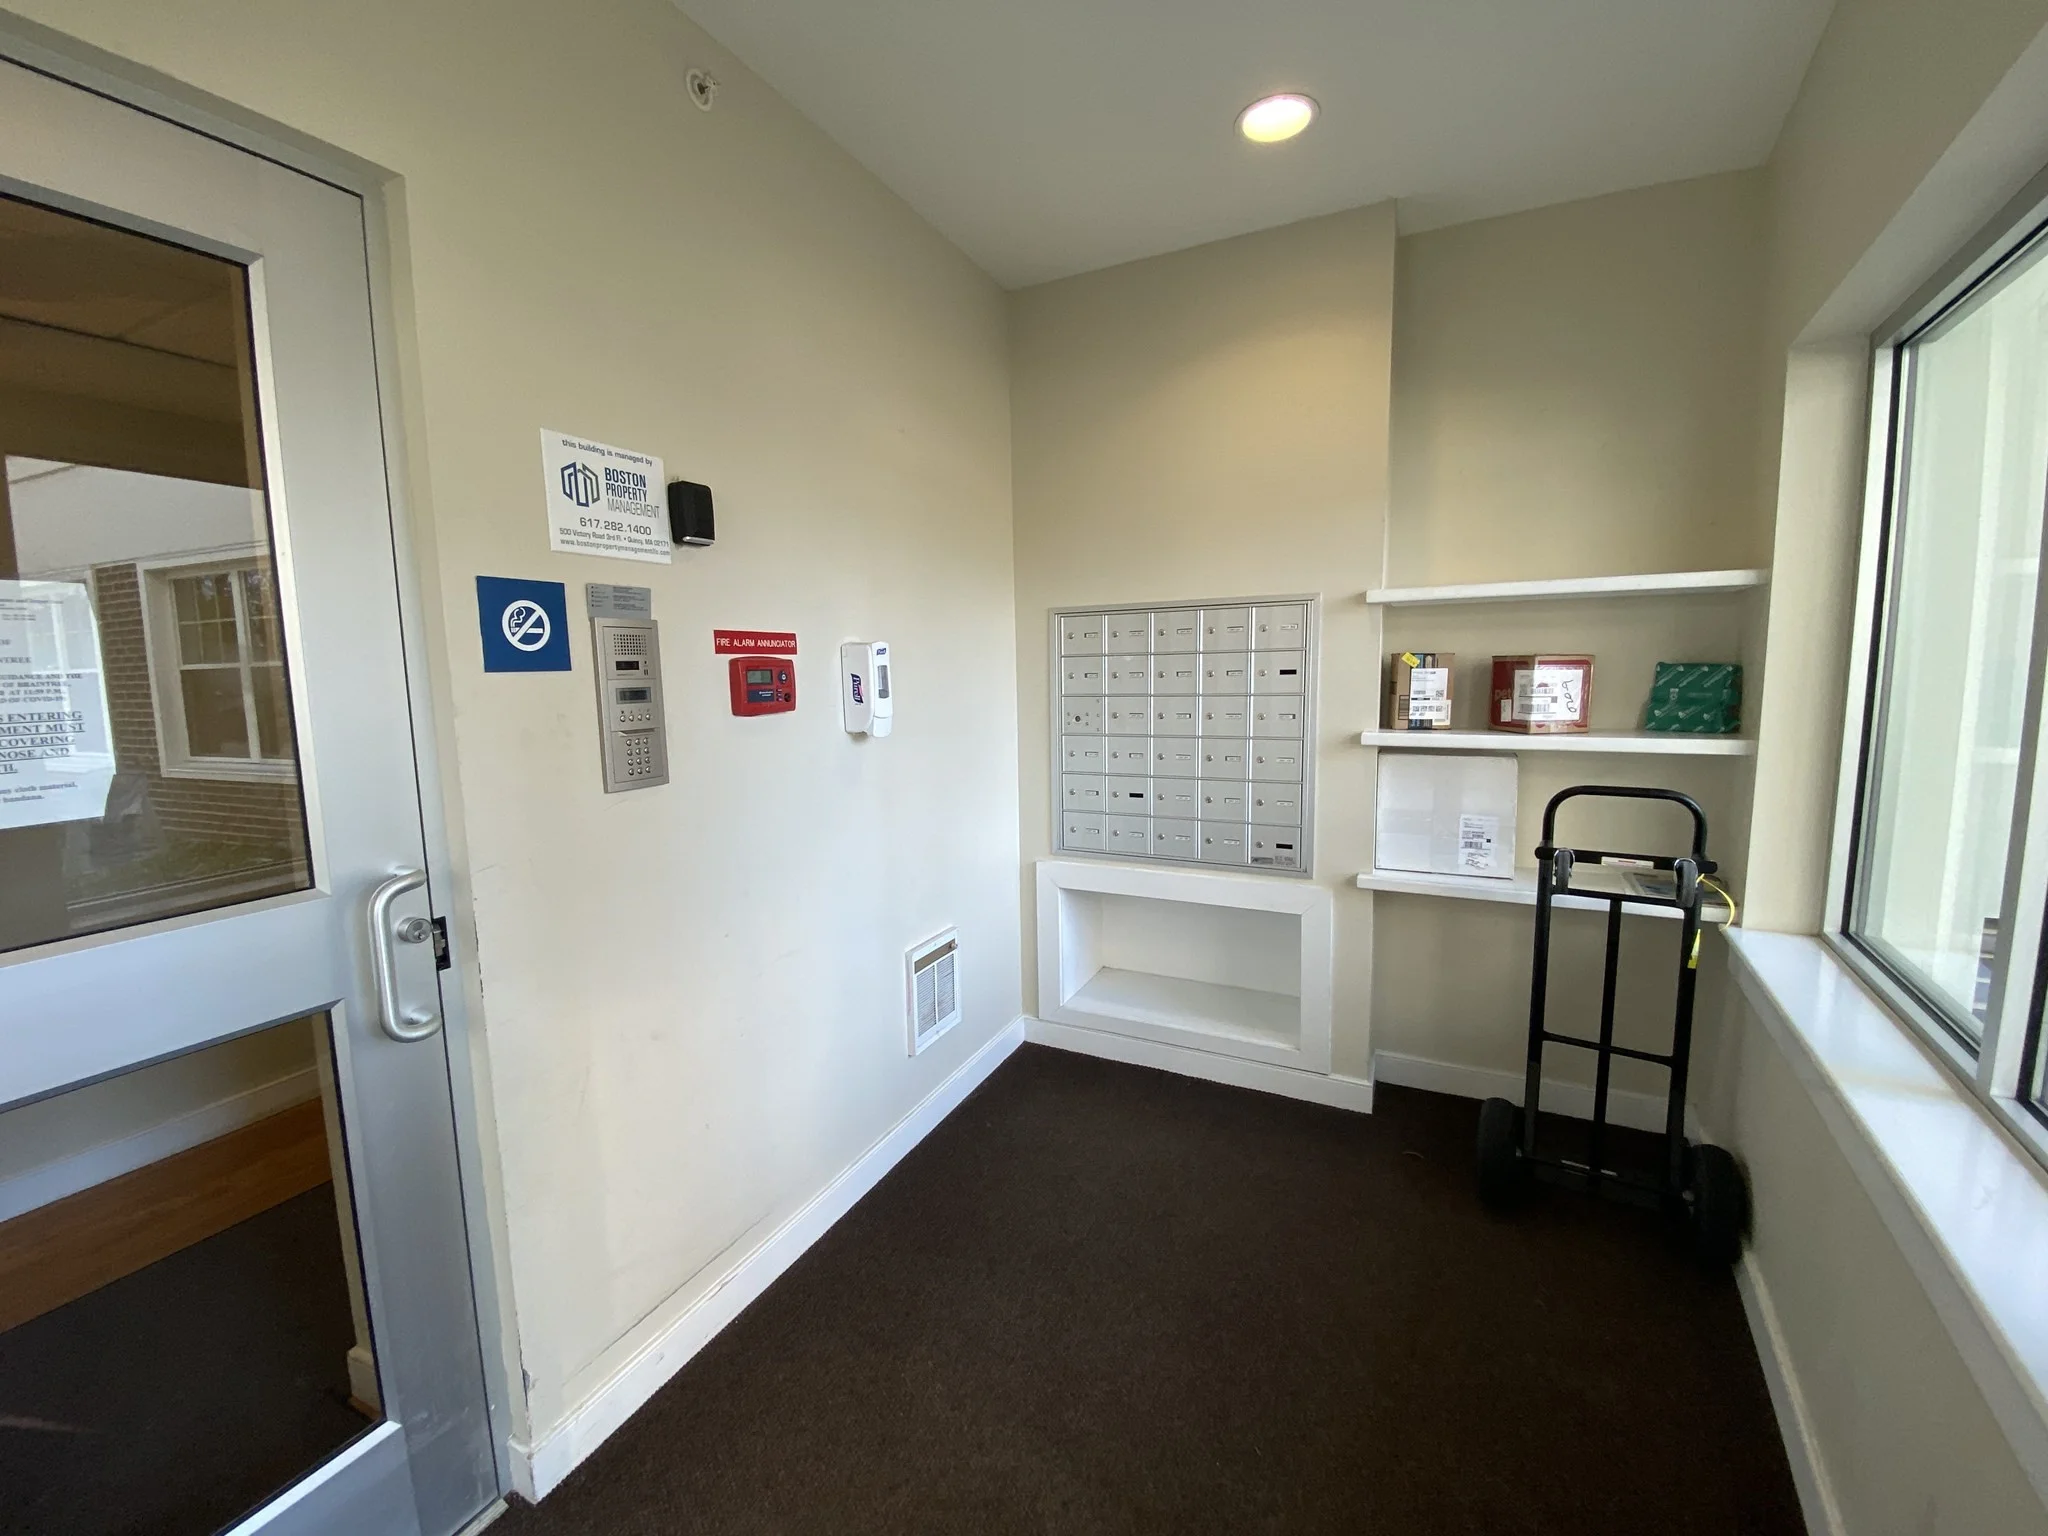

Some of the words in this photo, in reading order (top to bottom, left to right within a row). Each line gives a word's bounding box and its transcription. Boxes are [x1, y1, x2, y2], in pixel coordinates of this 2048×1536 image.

[562, 439, 577, 449] this
[578, 442, 606, 457] building
[606, 448, 613, 456] is
[614, 451, 644, 465] managed
[645, 457, 653, 467] by
[604, 467, 647, 489] BOSTON
[605, 482, 648, 503] PROPERTY
[607, 497, 660, 519] MANAGEMENT
[579, 517, 652, 536] 617.282.1400
[716, 637, 731, 647] FIRE
[733, 638, 755, 647] ALARM
[757, 639, 796, 648] ANNUNCIATOR
[8, 711, 82, 722] ENTERING
[45, 722, 84, 733] MUST
[0, 735, 75, 748] COVERING
[41, 747, 70, 758] AND
